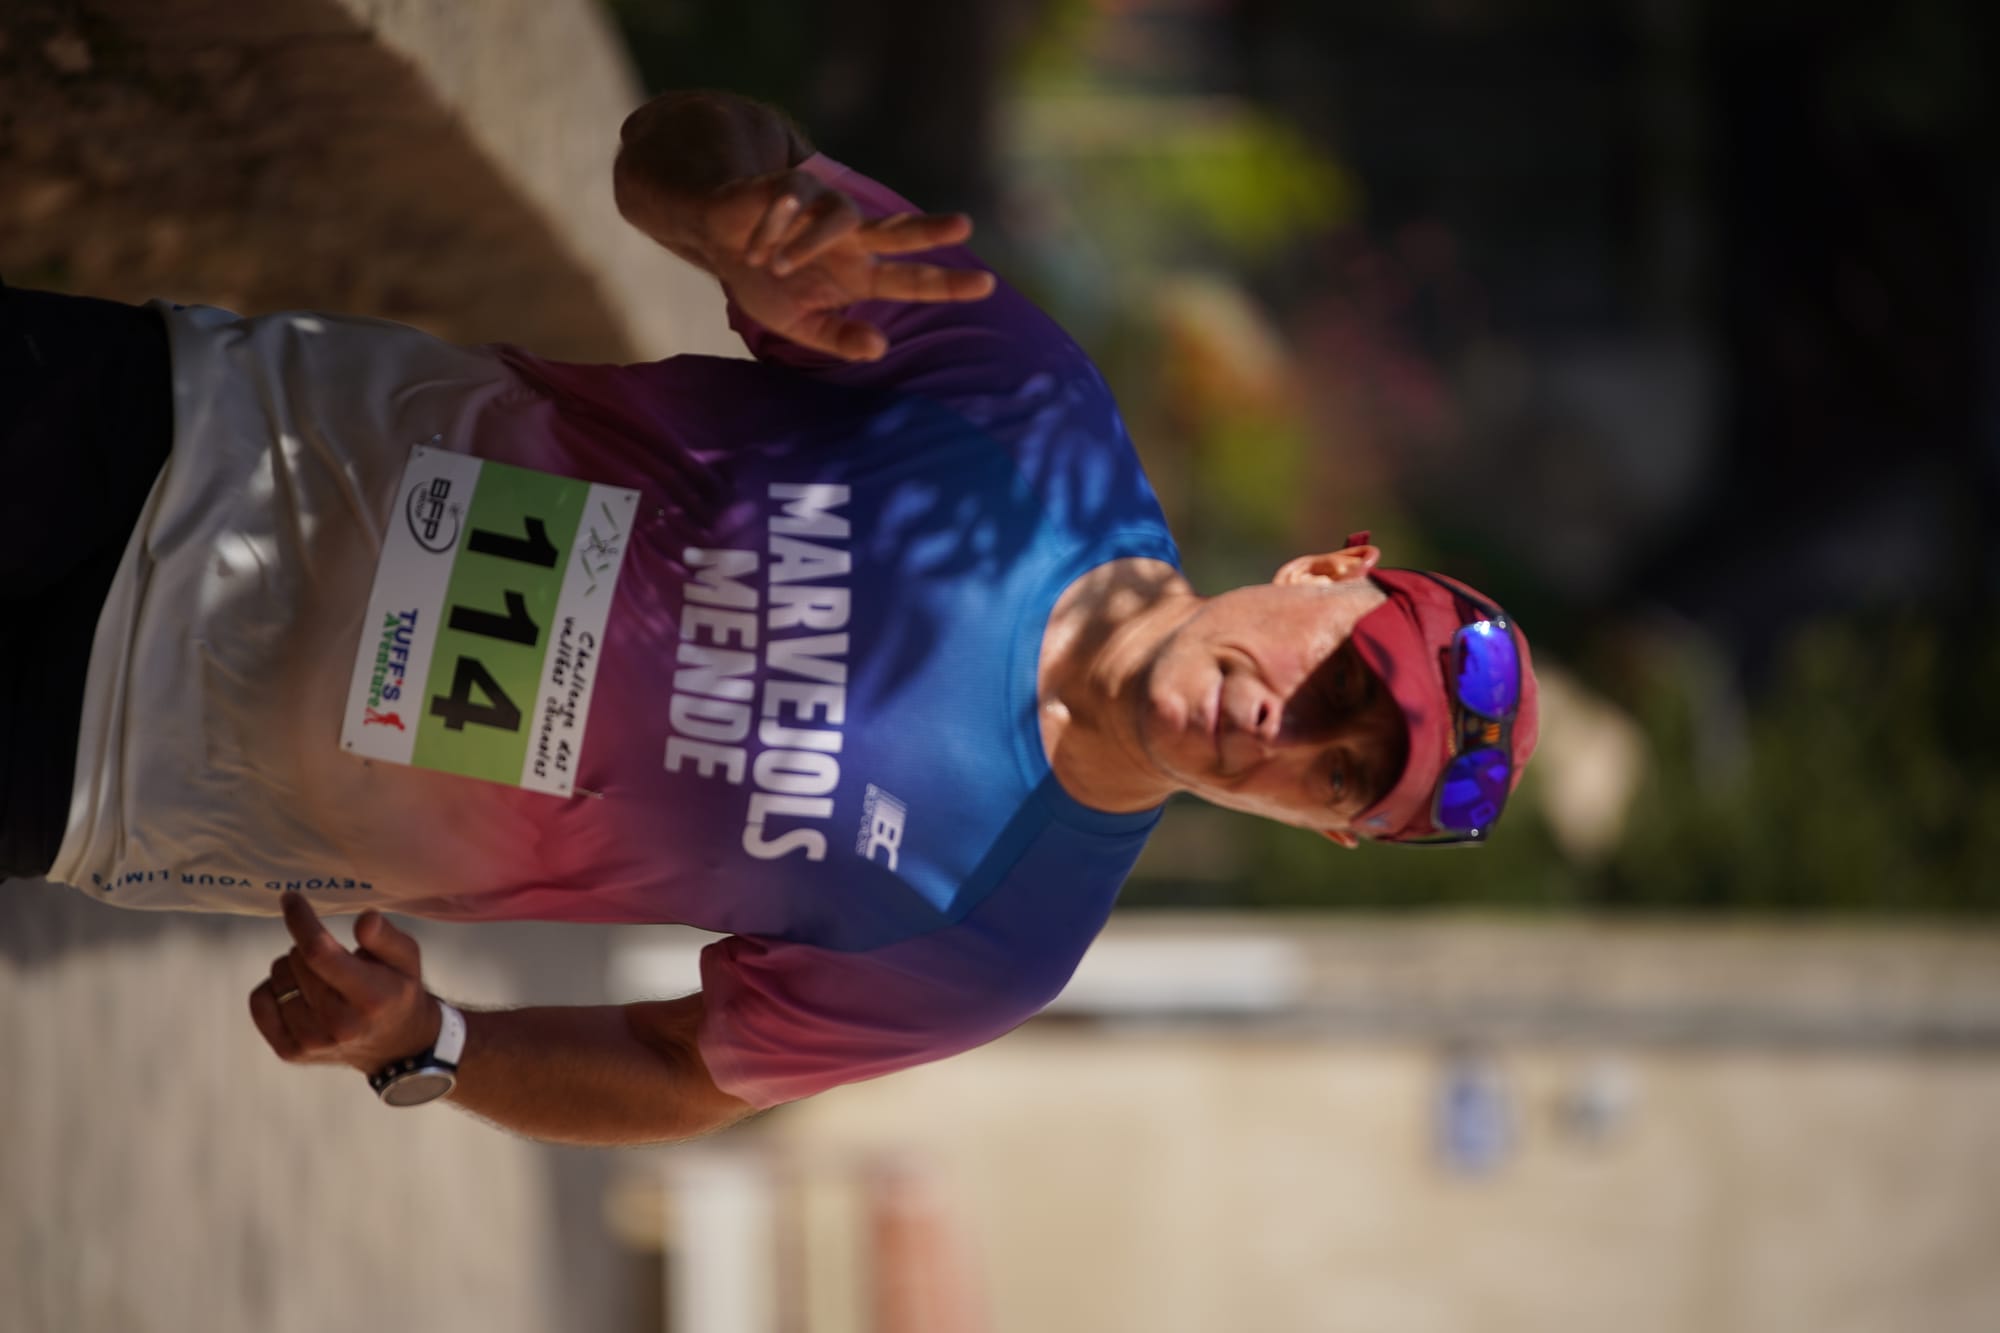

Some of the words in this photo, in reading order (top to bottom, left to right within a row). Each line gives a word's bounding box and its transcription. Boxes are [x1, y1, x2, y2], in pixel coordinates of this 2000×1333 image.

[425, 477, 452, 541] BFP
[368, 612, 394, 707] Aventure
[383, 608, 418, 701] TUFF'S
[430, 516, 559, 732] 114
[552, 616, 576, 687] vallées
[664, 546, 760, 785] MENDE
[557, 631, 595, 729] Challenge
[742, 482, 852, 862] MARVEJOLS
[556, 740, 572, 772] des
[181, 872, 252, 888] YOUR
[265, 878, 372, 893] BEYOND
